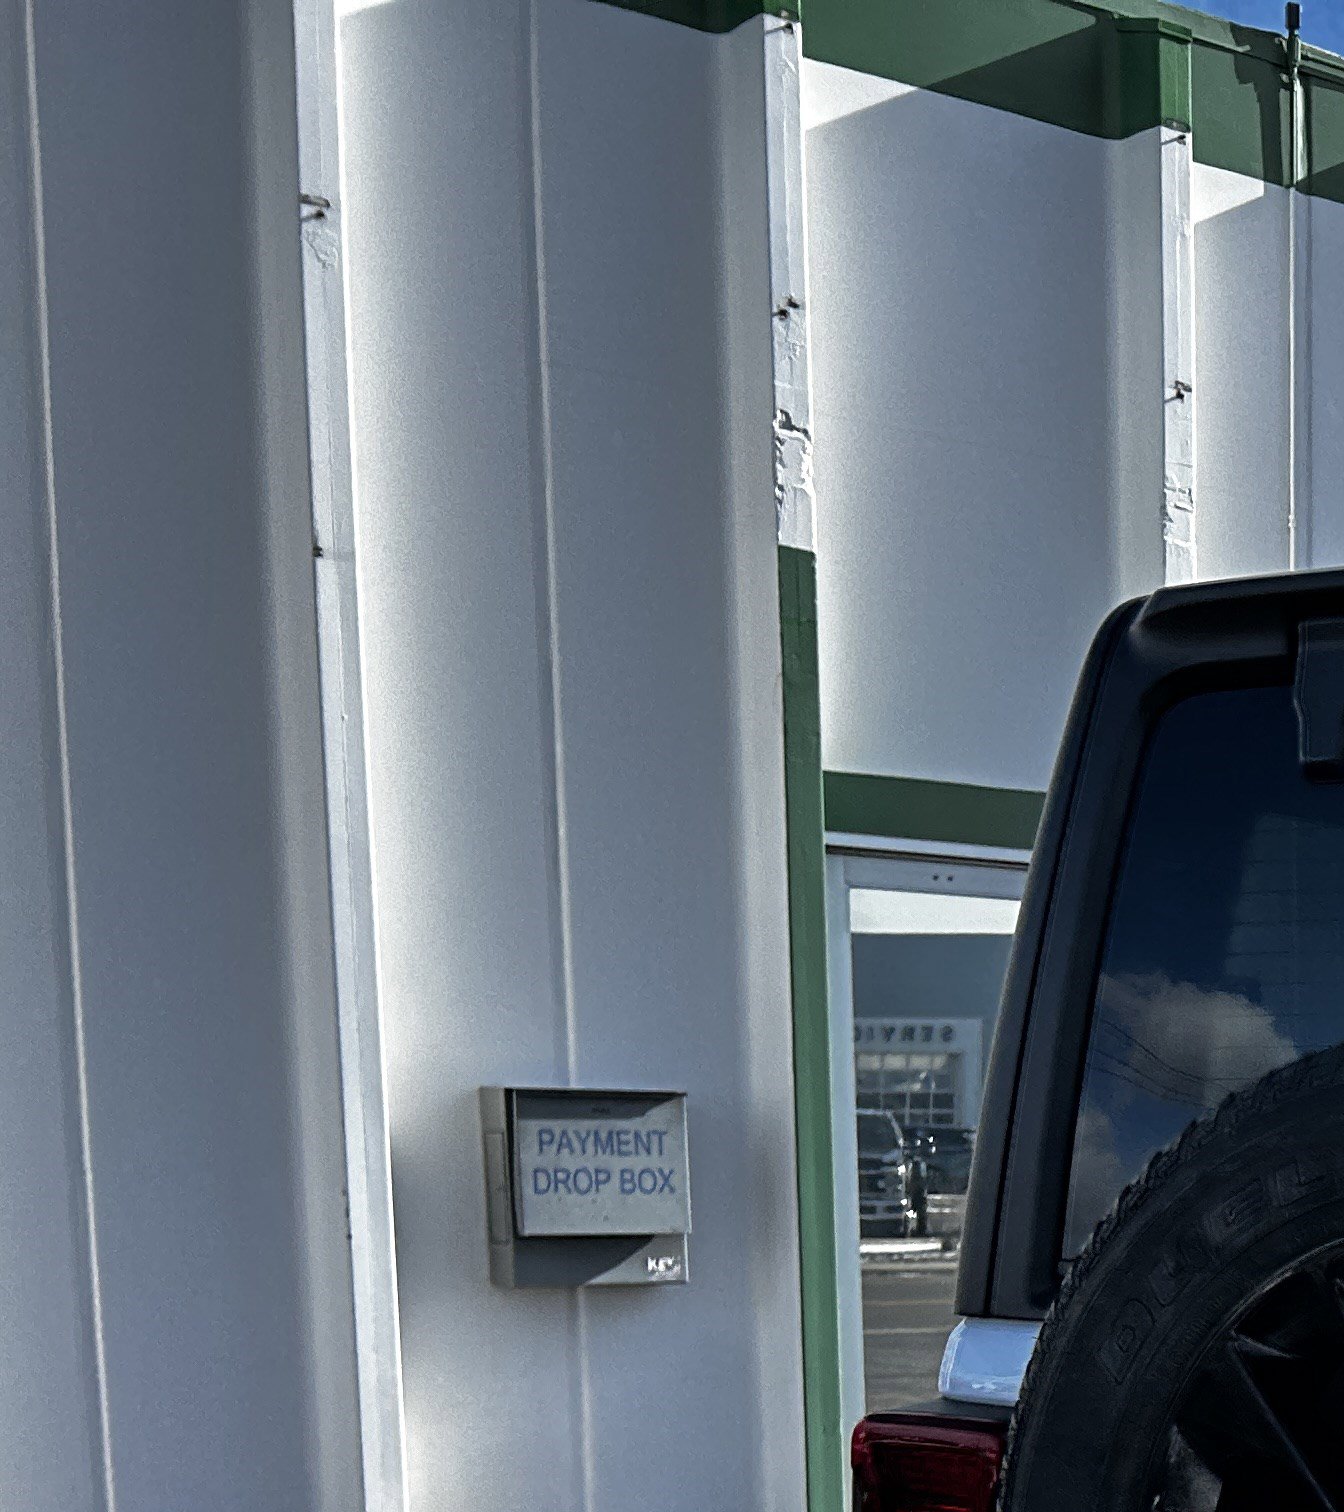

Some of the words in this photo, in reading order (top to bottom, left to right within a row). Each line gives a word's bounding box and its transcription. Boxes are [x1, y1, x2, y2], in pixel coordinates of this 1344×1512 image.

[536, 1128, 668, 1157] PAYMENT
[532, 1166, 612, 1196] DROP
[618, 1166, 677, 1196] BOX
